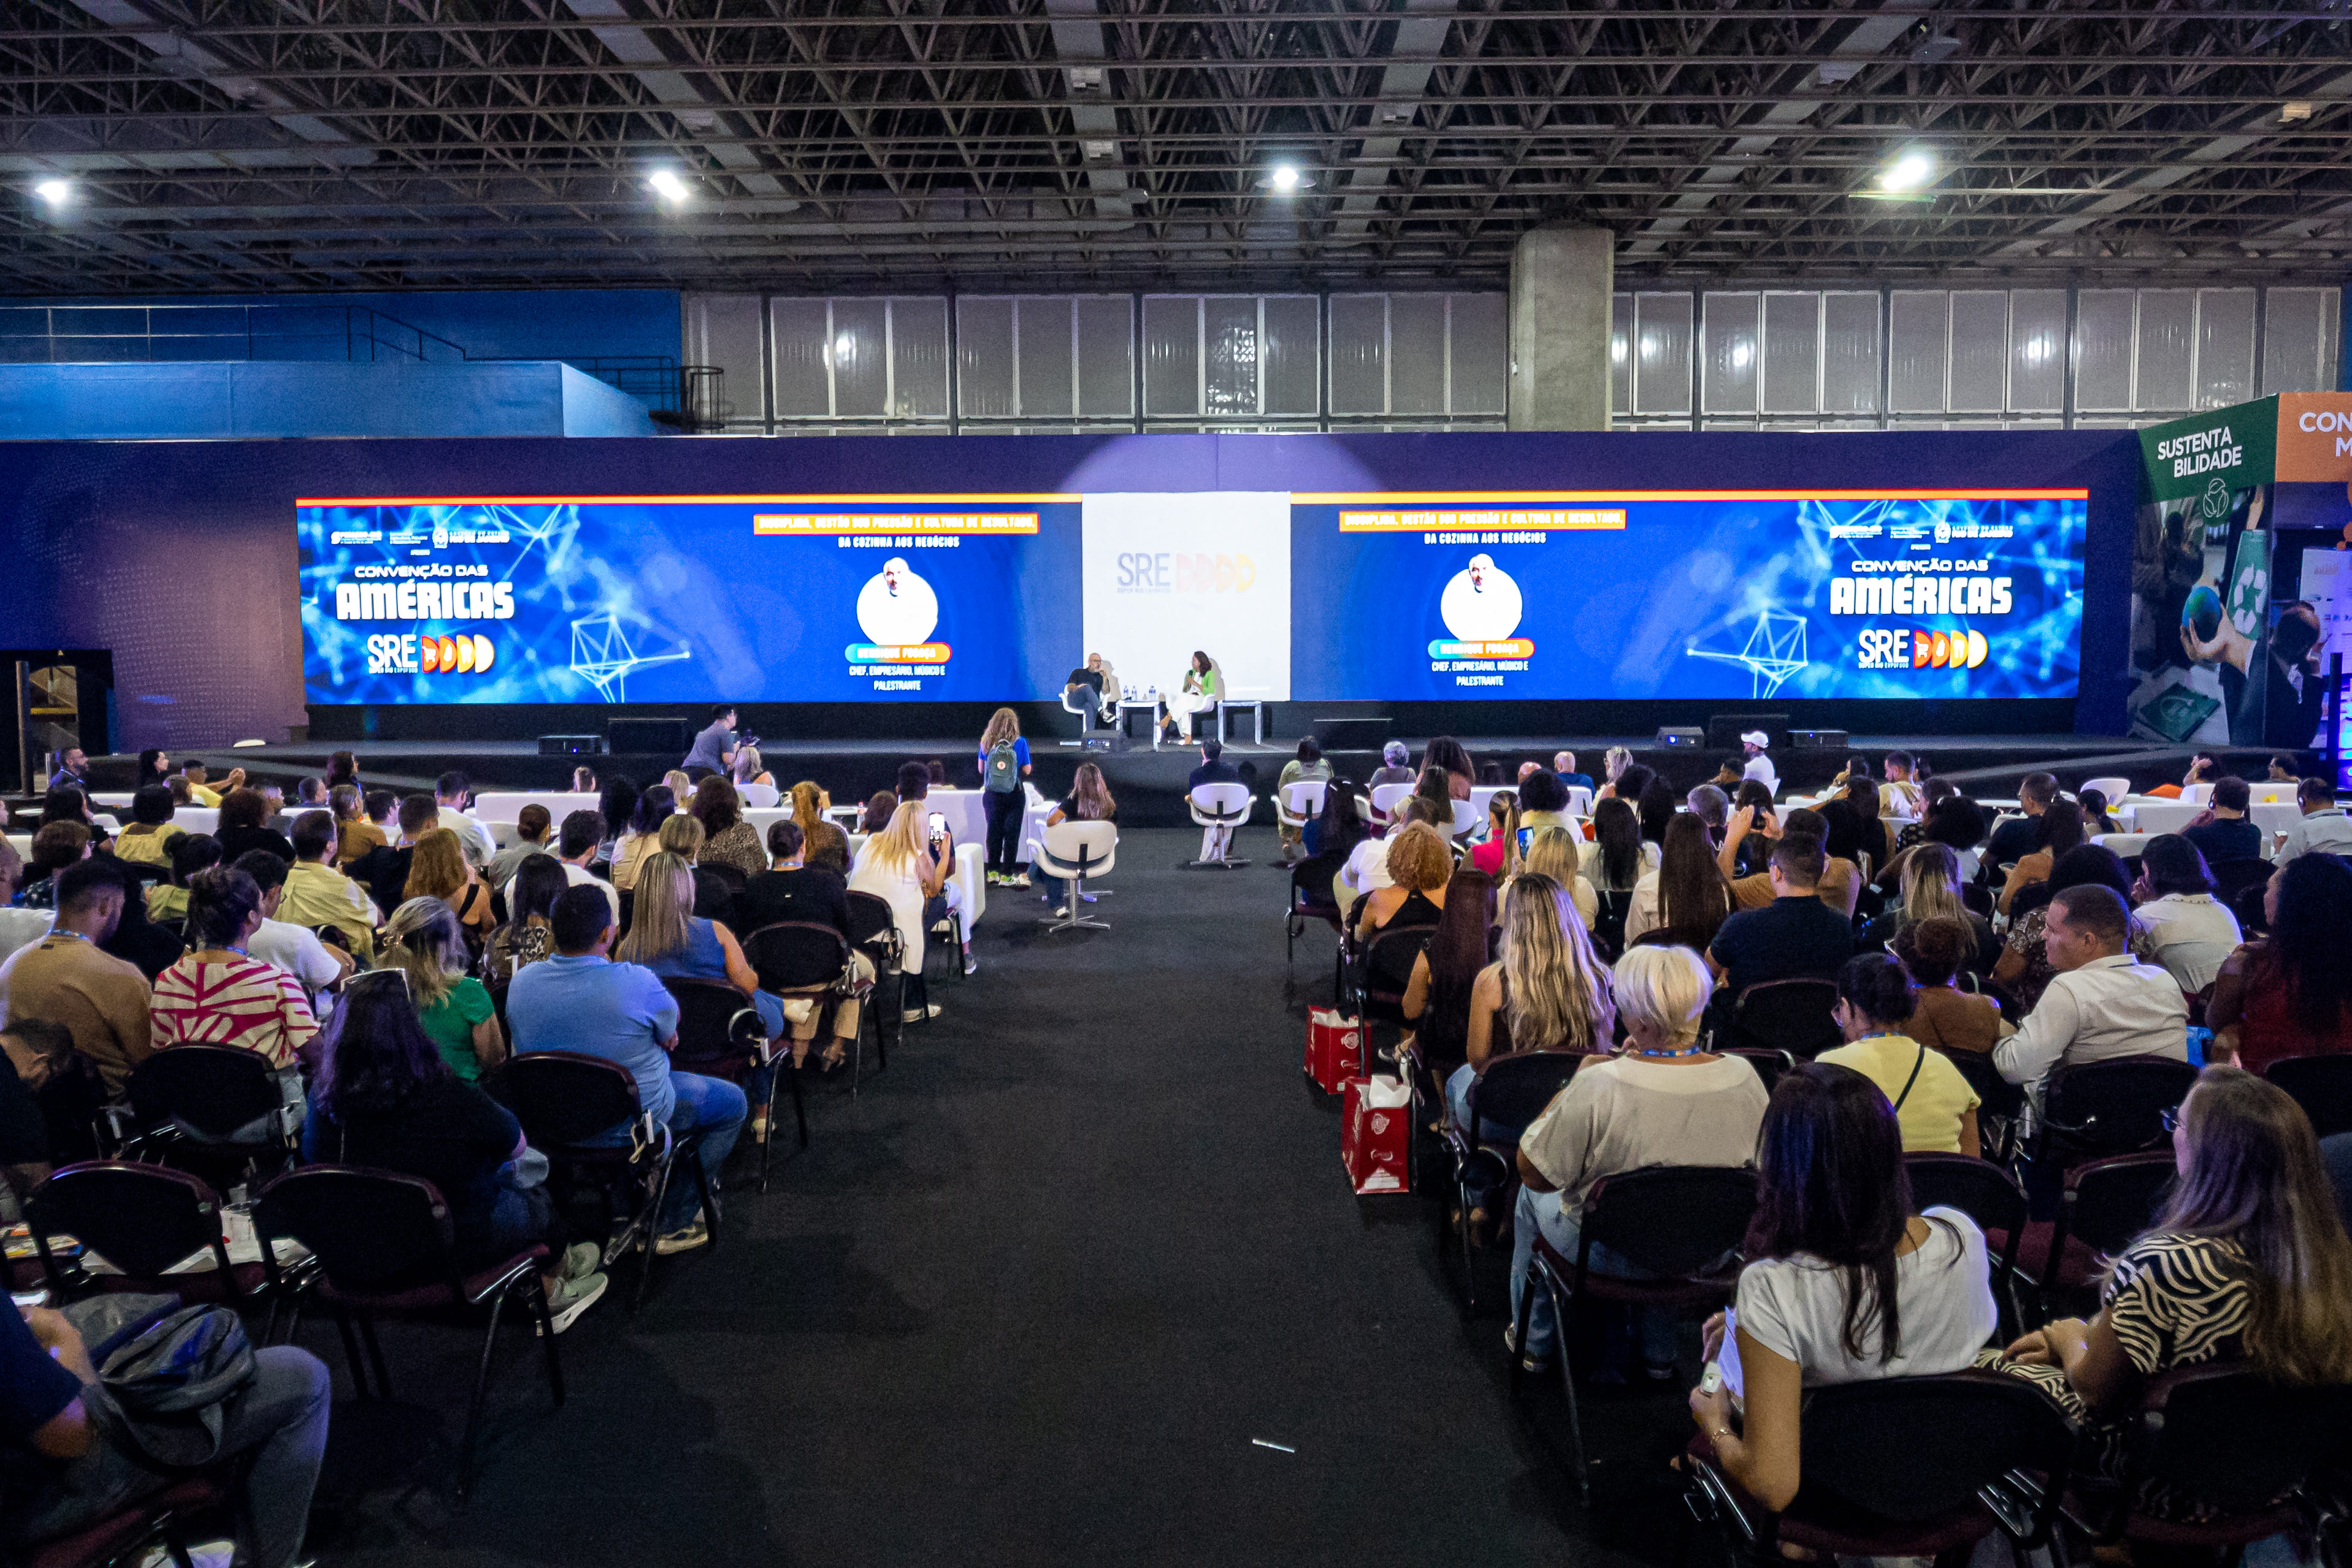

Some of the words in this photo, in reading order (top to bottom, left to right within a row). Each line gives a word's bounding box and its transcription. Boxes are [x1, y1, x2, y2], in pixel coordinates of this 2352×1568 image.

[2299, 411, 2352, 432] CON
[2157, 426, 2232, 460] SUSTENTA
[2174, 446, 2242, 478] BILIDADE
[838, 537, 851, 548] DA
[852, 537, 892, 548] COZINHA
[895, 537, 913, 548] AOS
[915, 535, 960, 548] NEGÓCIOS
[1424, 533, 1437, 544] DA
[1439, 533, 1479, 544] COZINHA
[1481, 532, 1499, 544] AOS
[1501, 531, 1546, 544] NEGÓCIOS
[354, 563, 453, 579] CONVENÇÃO
[455, 565, 488, 576] DAS
[1117, 553, 1171, 587] SRE
[1851, 558, 1952, 575] CONVENÇÃO
[1955, 559, 1988, 572] DAS
[336, 578, 515, 620] AMÉRICAS
[1830, 573, 2012, 614] AMÉRICAS
[367, 633, 418, 668] SRE
[1858, 629, 1910, 663] SRE
[940, 665, 945, 676] E
[1523, 661, 1528, 671] E
[873, 680, 921, 690] PALESTRANTE
[1456, 676, 1504, 686] PALESTRANTE
